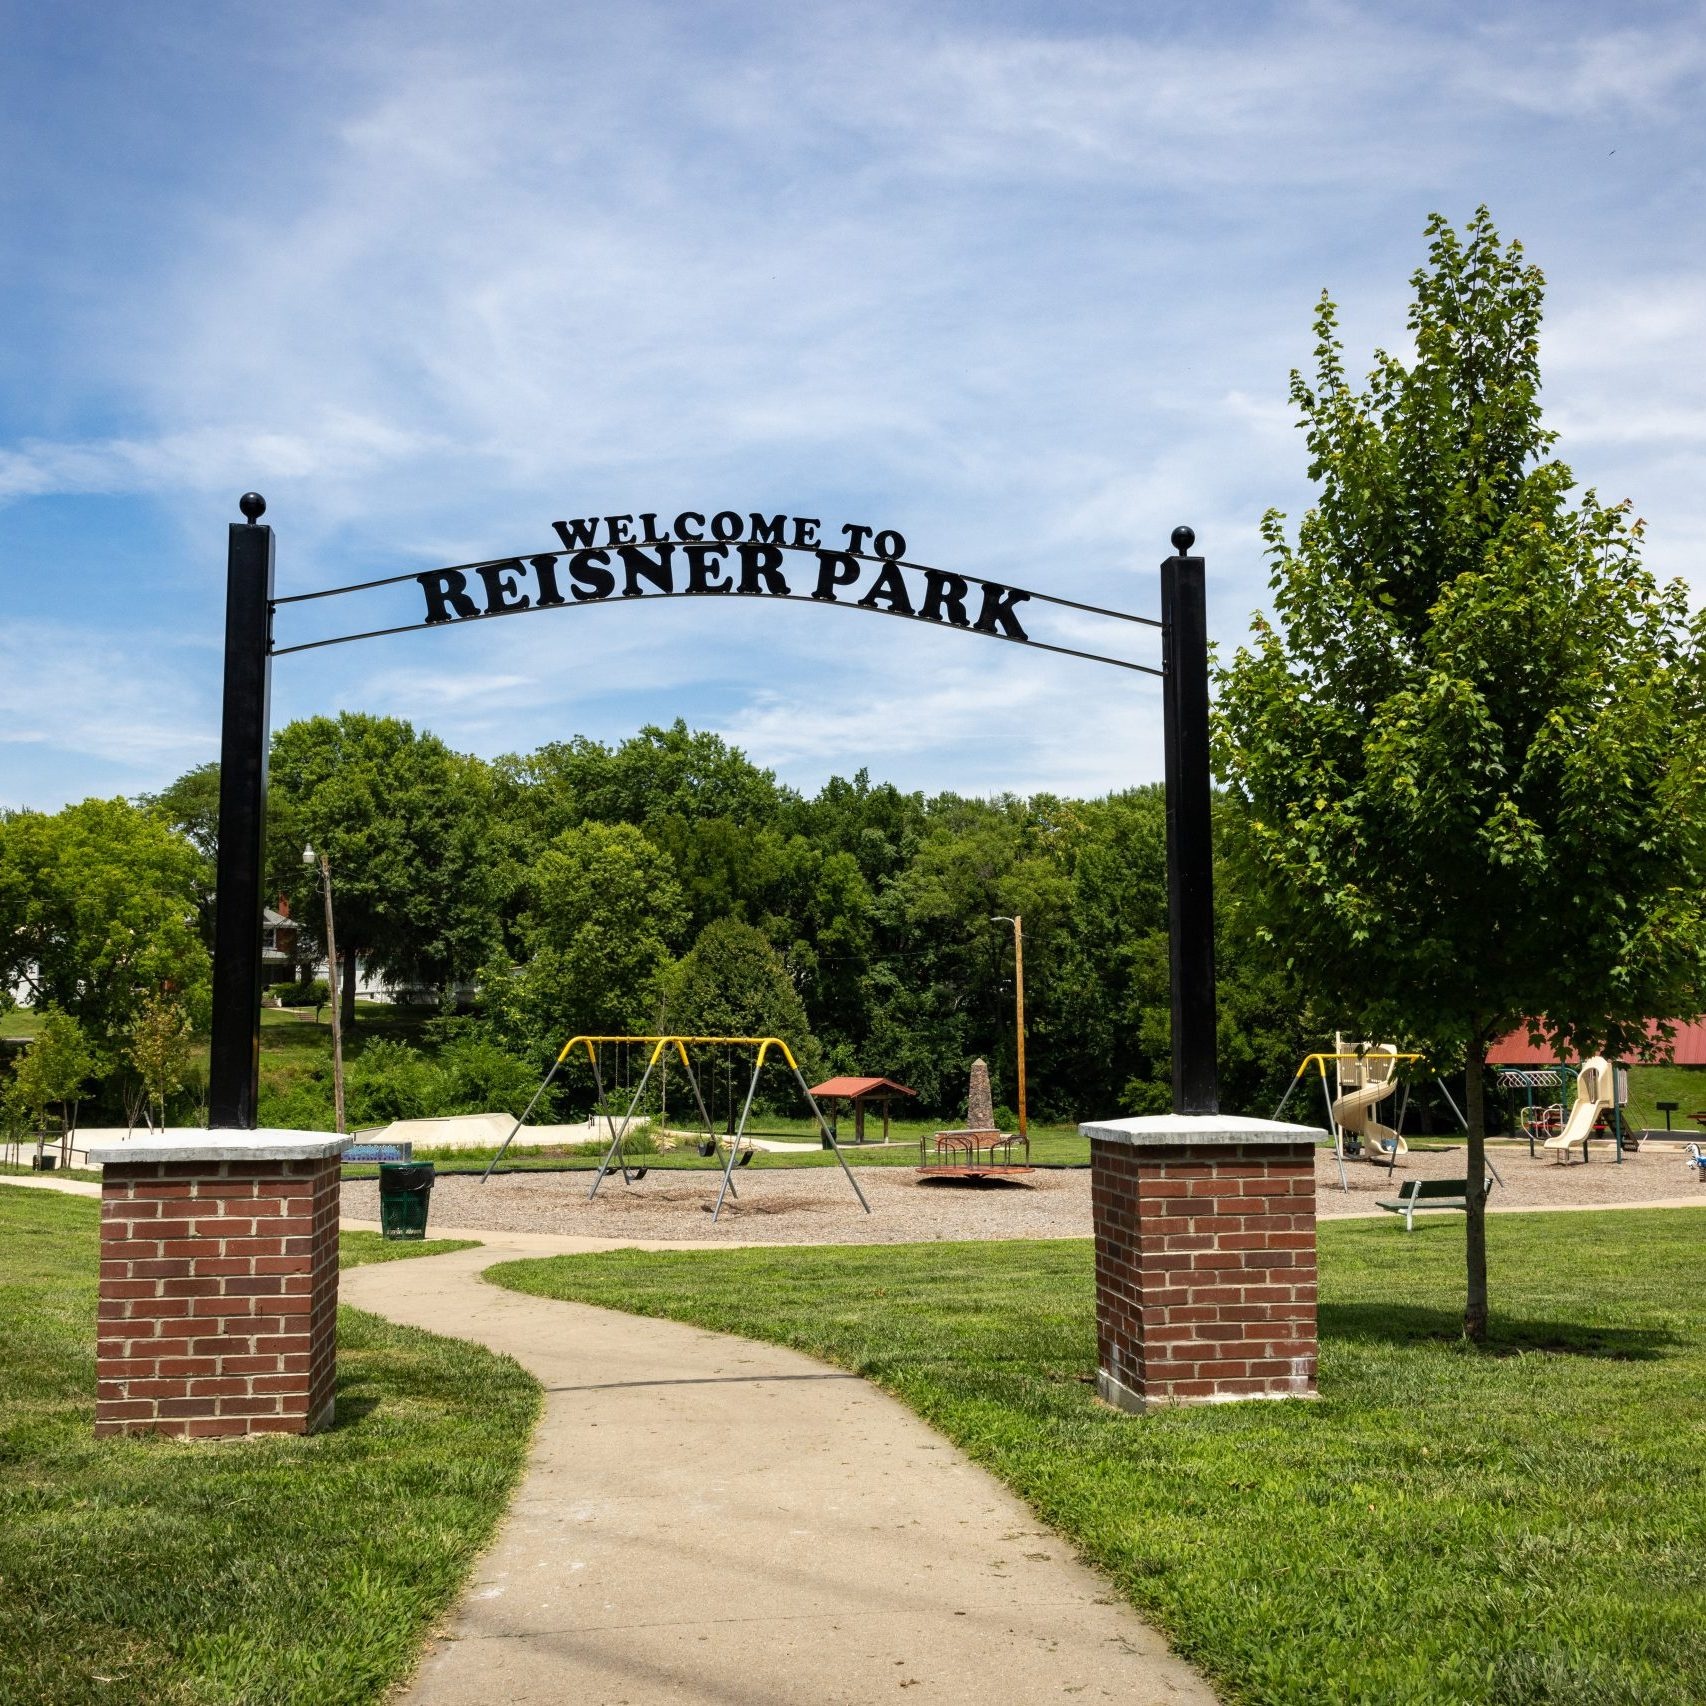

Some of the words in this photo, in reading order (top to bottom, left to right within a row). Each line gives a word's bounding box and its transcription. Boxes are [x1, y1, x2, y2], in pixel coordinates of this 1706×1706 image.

[552, 511, 822, 550] WELCOME
[842, 523, 906, 560] TO
[417, 543, 791, 624] REISNER
[811, 551, 1031, 641] PARK
